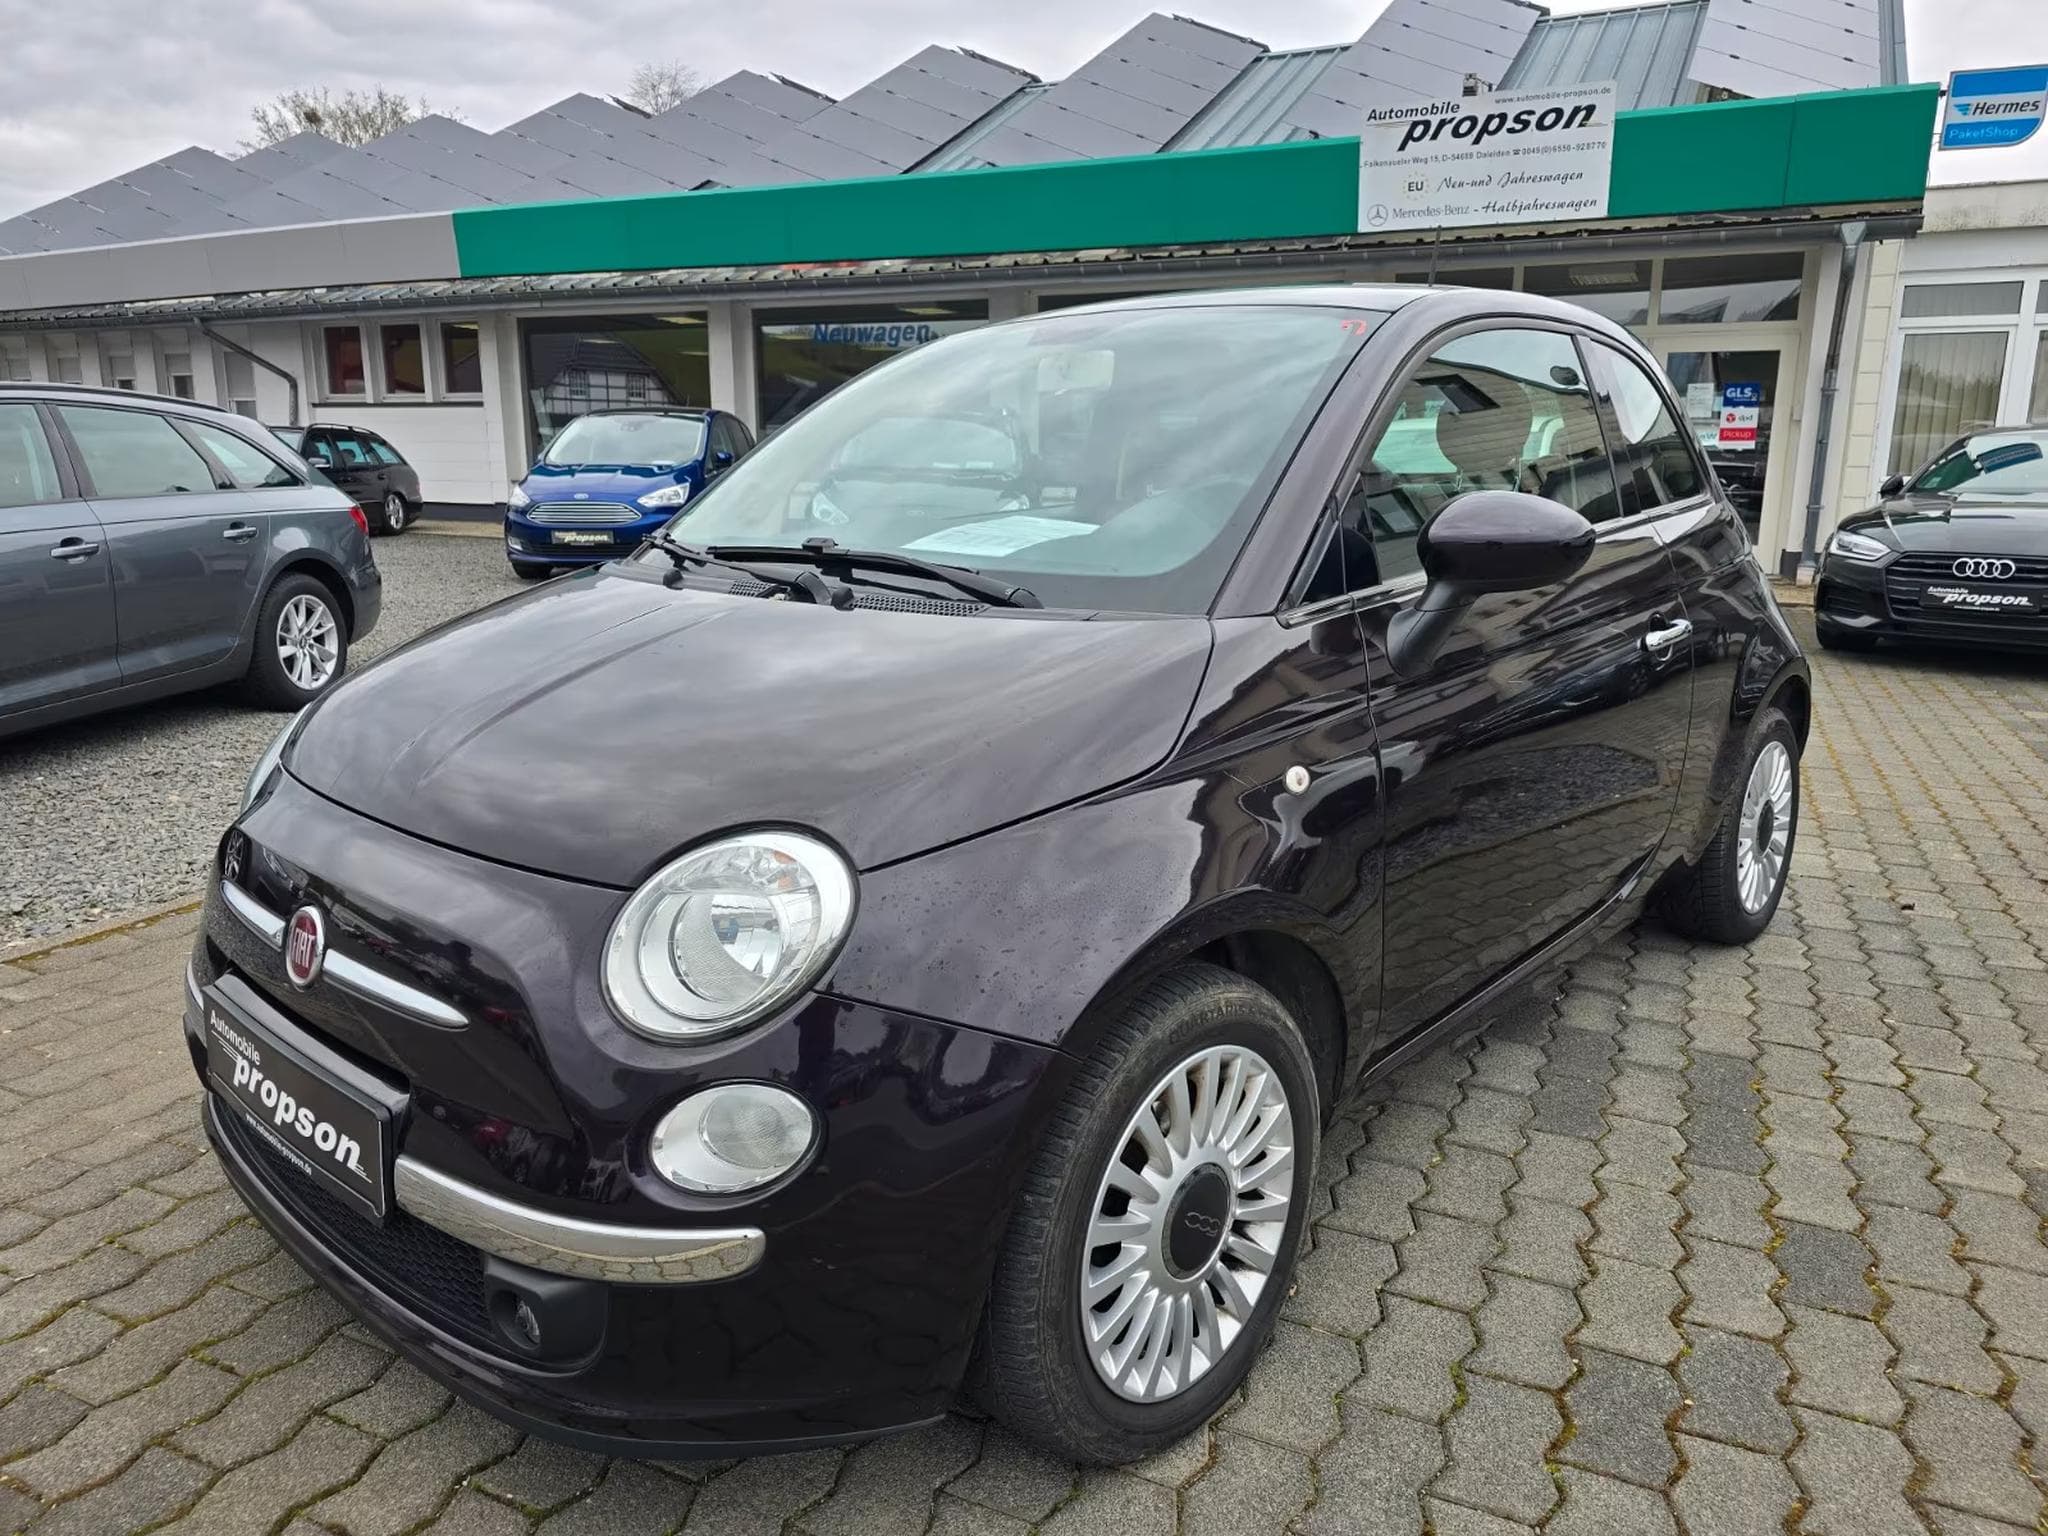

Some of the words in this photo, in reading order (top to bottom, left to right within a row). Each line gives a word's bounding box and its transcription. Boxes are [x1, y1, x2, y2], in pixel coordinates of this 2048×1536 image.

[1367, 101, 1460, 122] Automobile
[1972, 100, 2041, 116] Hermes
[1396, 103, 1597, 152] propson
[1949, 126, 2018, 139] PaketShop
[1407, 181, 1424, 192] EU
[1437, 174, 1493, 192] Neu-und
[1497, 170, 1584, 187] Jahreswagen
[1392, 205, 1470, 219] Mercedes-Benz
[814, 324, 931, 347] Neuwagen
[1726, 387, 1752, 398] GLS
[1942, 593, 2029, 606] propson
[291, 927, 316, 969] FIAT
[210, 1010, 261, 1066] Automobile
[233, 1055, 361, 1169] propson
